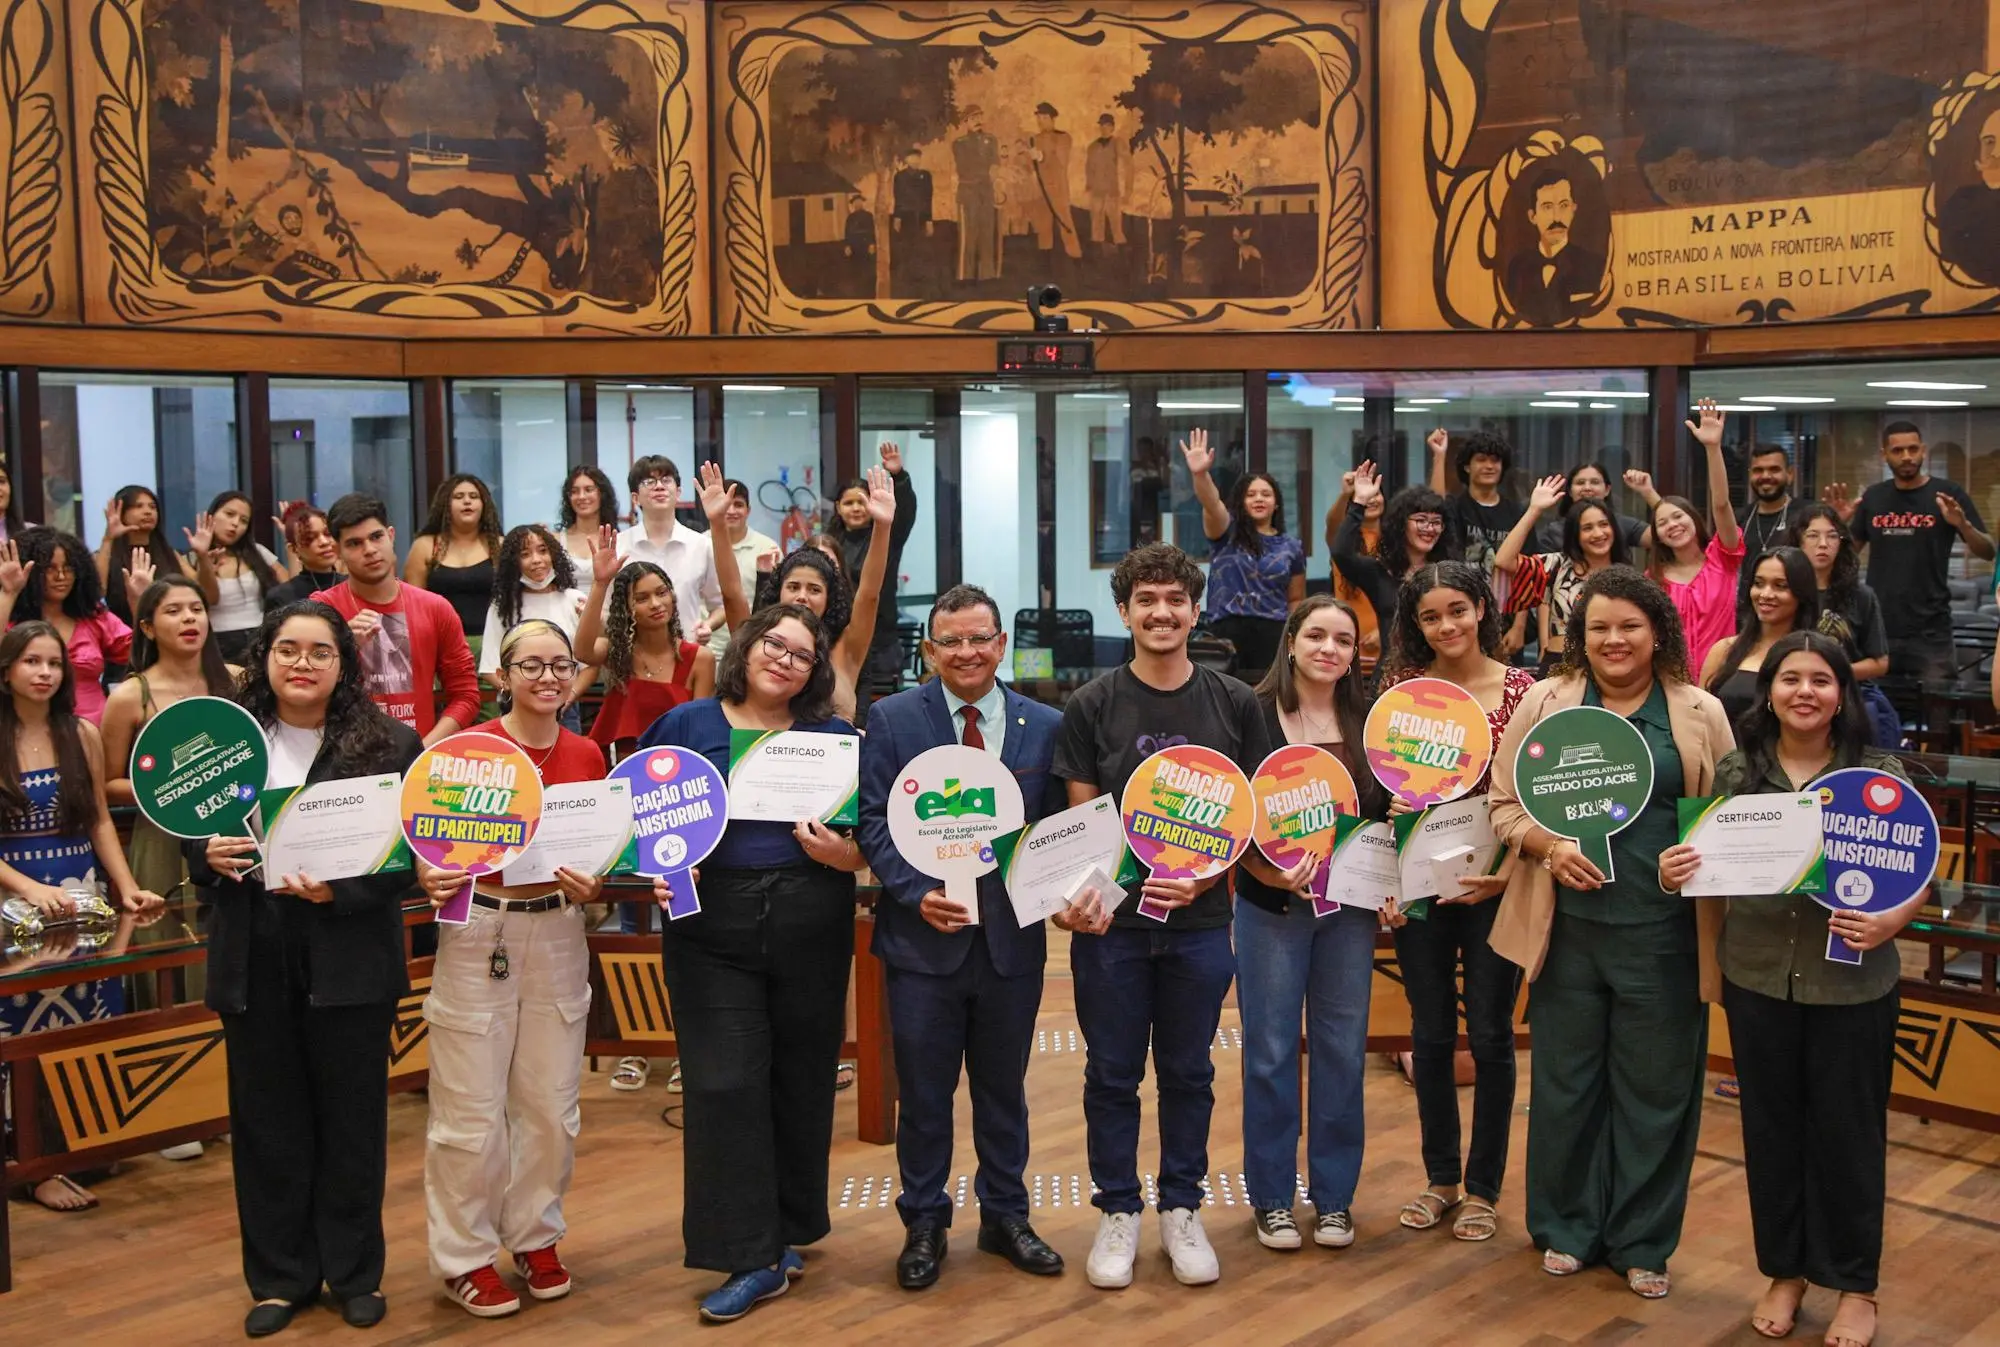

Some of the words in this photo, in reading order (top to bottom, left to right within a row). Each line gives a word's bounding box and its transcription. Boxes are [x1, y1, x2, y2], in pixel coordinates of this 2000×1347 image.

[1668, 173, 1747, 193] BOLIVA
[1690, 206, 1813, 234] MAPPA
[1627, 246, 1709, 267] MOSTRANDO
[1713, 247, 1723, 260] A
[1730, 243, 1764, 260] NOVA
[1771, 236, 1844, 255] FRONTEIRA
[1850, 231, 1895, 250] NORTE
[1637, 274, 1735, 297] BRASIL
[1778, 263, 1895, 289] BOLIVIA
[1046, 346, 1057, 361] 4
[390, 703, 415, 717] YORK
[1388, 710, 1466, 748] REDAÇÃO
[765, 746, 825, 757] CERTIFICADO
[1395, 741, 1419, 756] NOTA
[1414, 741, 1460, 770] 1000
[154, 769, 195, 796] ASSEMBLEIA
[194, 746, 237, 772] LEGISLATIVA
[236, 739, 248, 750] DO
[156, 776, 203, 808] ESTADO
[202, 766, 222, 782] DO
[223, 747, 255, 772] ACRE
[430, 754, 517, 789] REDAÇÃO
[1532, 772, 1577, 783] ASSEMBLEIA
[1578, 765, 1622, 777] LEGISLATIVA
[1623, 763, 1635, 771] DO
[632, 783, 681, 815] CAÇÃO
[682, 775, 711, 799] QUE
[1155, 759, 1235, 806] REDAÇÃO
[1264, 777, 1332, 816] REDAÇÃO
[1532, 780, 1581, 795] ESTADO
[1582, 777, 1602, 789] DO
[1604, 772, 1638, 785] ACRE
[298, 794, 365, 812] CERTIFICADO
[438, 789, 465, 804] NOTA
[461, 786, 512, 815] 1000
[543, 798, 597, 812] ERTIFICADO
[914, 778, 996, 821] ela
[1159, 792, 1184, 810] NOTA
[1178, 795, 1227, 829] 1000
[415, 816, 435, 837] EU
[437, 818, 522, 844] PARTICIPEI!
[634, 799, 714, 839] ANSFORMA
[918, 827, 942, 836] Escola
[957, 824, 998, 834] Legislativo
[1280, 819, 1301, 835] NOTA
[1298, 802, 1335, 835] 1000
[1425, 814, 1473, 833] CERTIFICADO
[1716, 811, 1783, 823] CERTIFICADO
[1821, 811, 1889, 842] UCAÇÃO
[1892, 822, 1925, 847] QUE
[942, 832, 975, 841] Acreano
[1028, 822, 1086, 851] CERTIFICADO
[1133, 814, 1152, 835] EU
[1152, 819, 1230, 858] PARTICIPEI!
[1361, 834, 1398, 849] CERTIFICA
[1823, 838, 1915, 874] ANSFORMA
